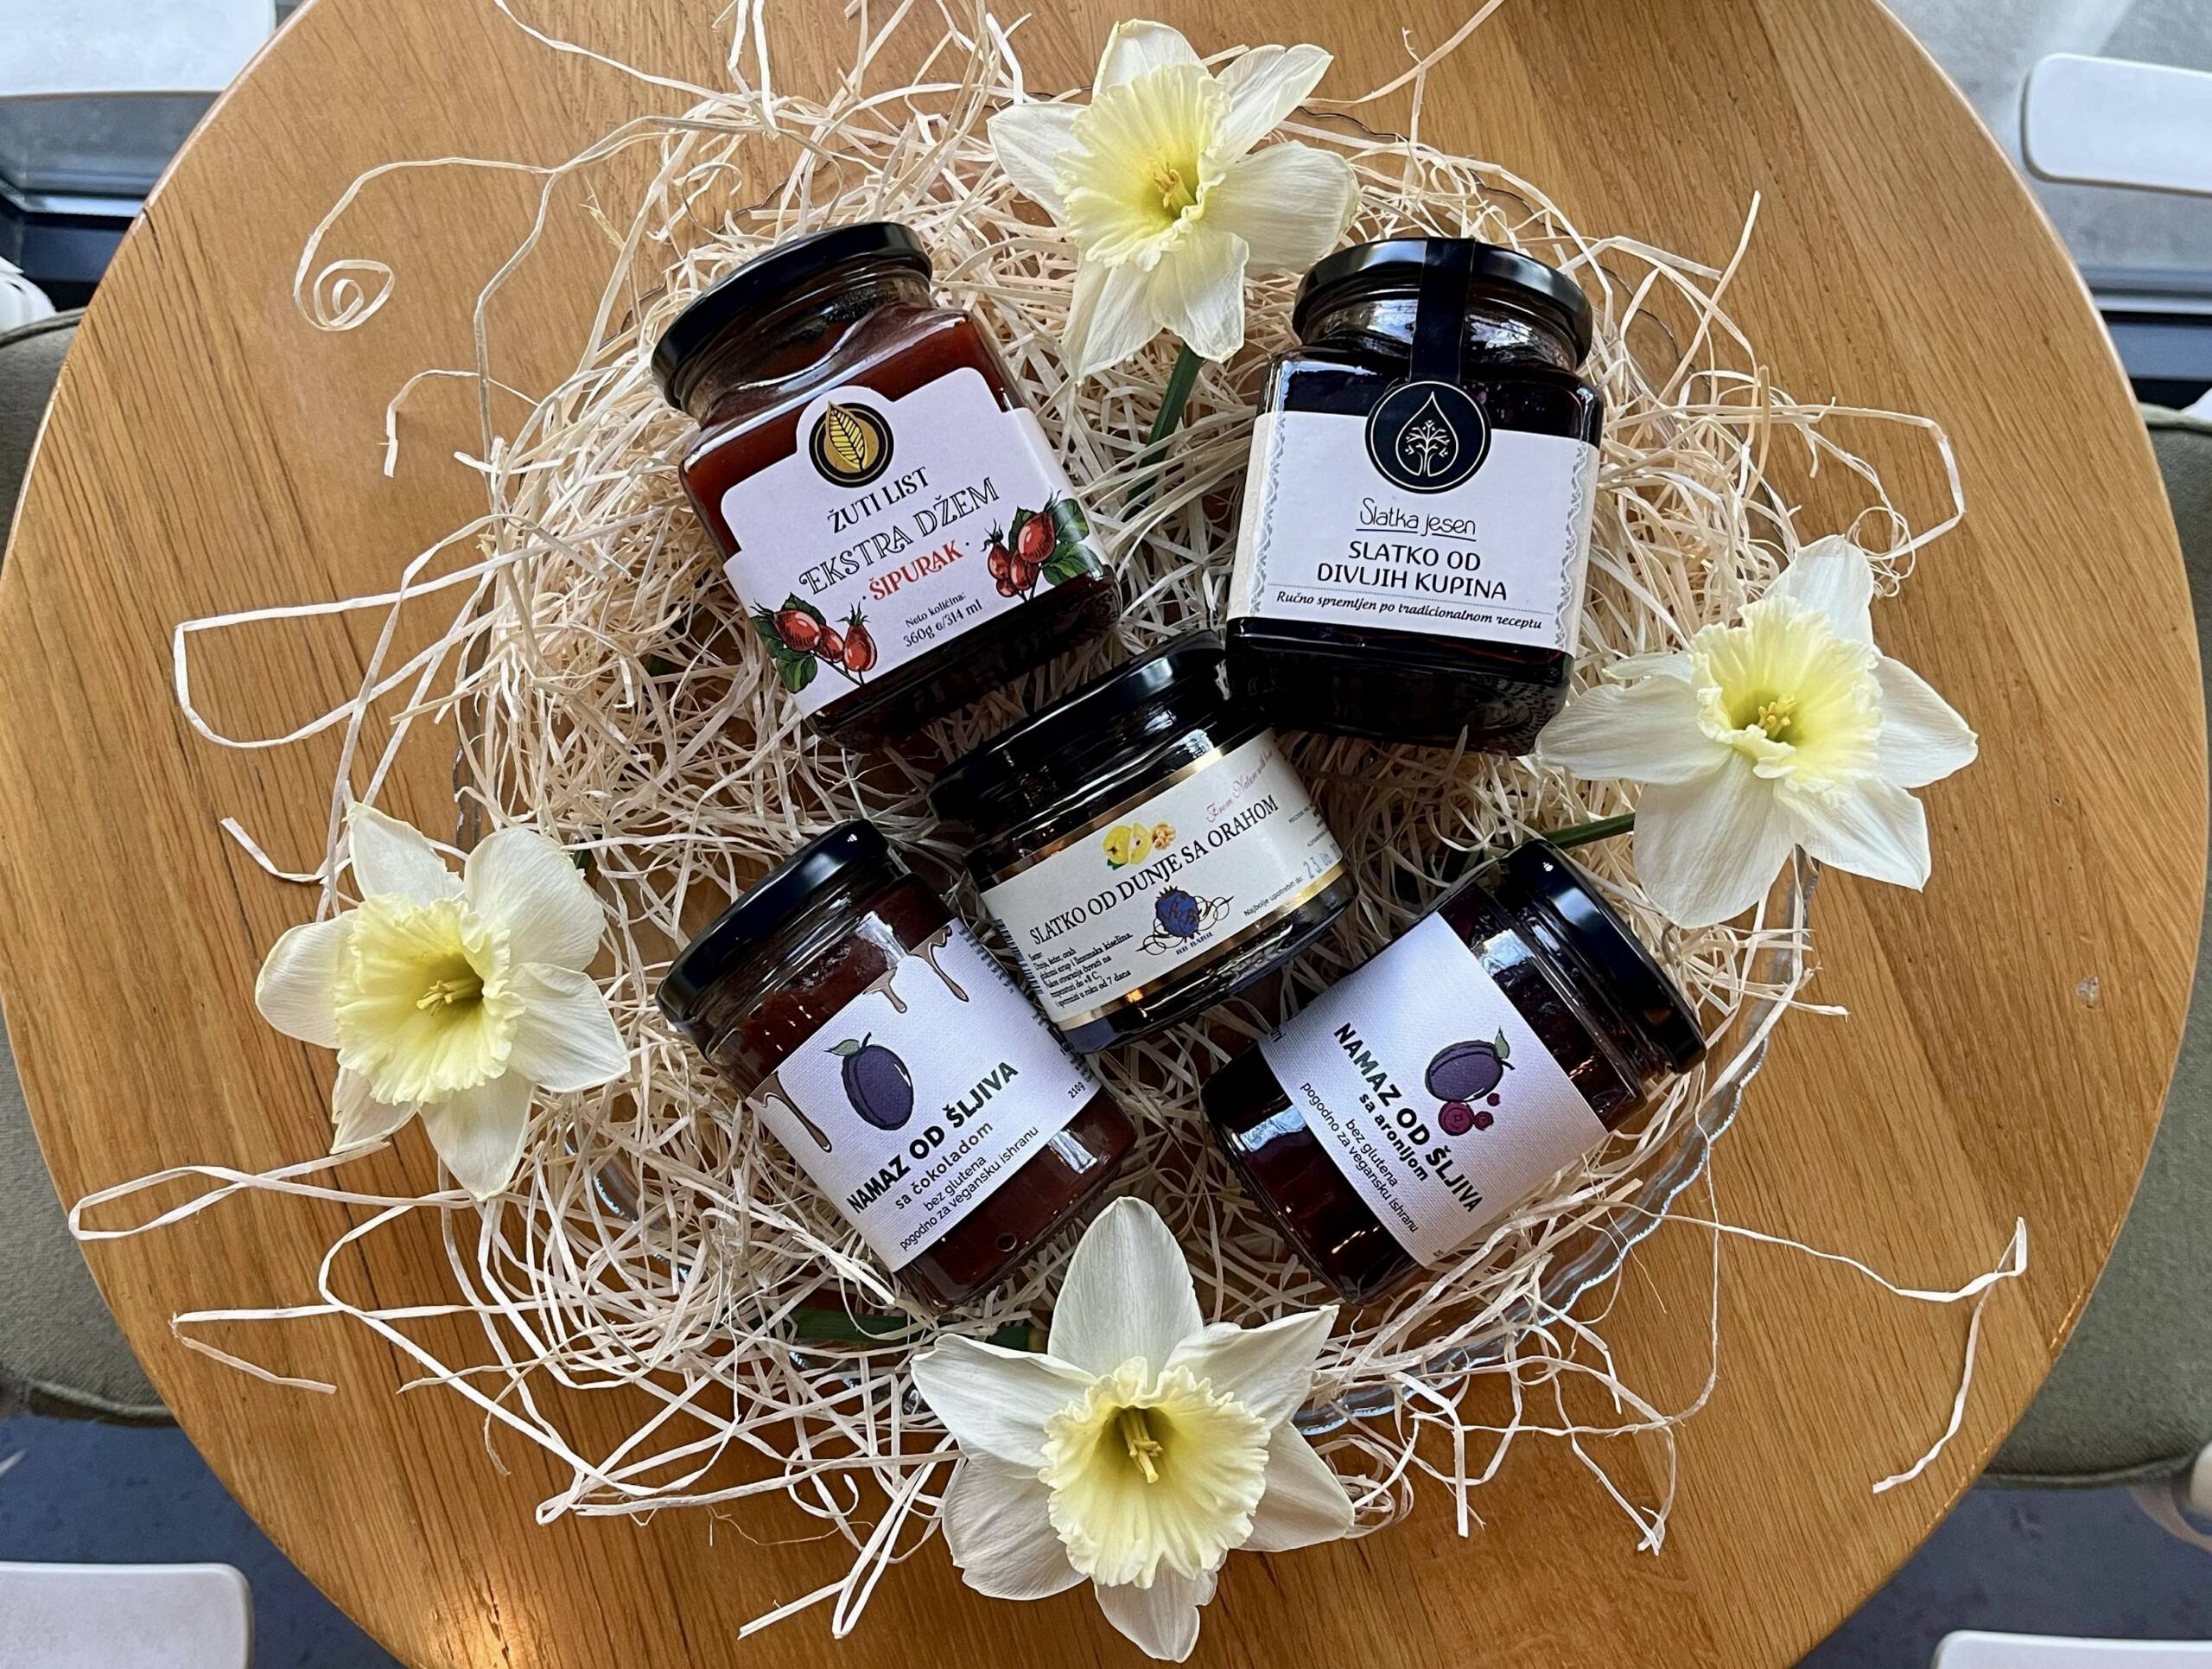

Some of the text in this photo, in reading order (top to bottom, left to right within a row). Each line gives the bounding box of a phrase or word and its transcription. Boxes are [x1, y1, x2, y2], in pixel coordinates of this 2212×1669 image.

[827, 467, 931, 533] ŽUTI LIST
[1360, 498, 1475, 536] Slatka jesen
[799, 477, 1000, 595] EKSTRA DŽEM
[1348, 540, 1480, 571] SLATKO OD
[868, 540, 963, 601] ŠIPURAK
[1317, 563, 1506, 601] DIVLJIH KUPINA
[903, 625, 935, 647] 360g
[966, 599, 982, 615] ml
[906, 592, 966, 627] Neto količina:
[1277, 591, 1541, 629] Ručno spremljen po tradicionalnom receptu
[1029, 906, 1086, 945] SLATKO
[1088, 889, 1119, 917] OD
[1118, 854, 1183, 901] DUNJE
[1184, 840, 1211, 866] SA
[1208, 794, 1279, 850] ORAHOM
[1068, 1081, 1086, 1099] 210g
[1333, 1023, 1483, 1213] NAMAZ OD ŠLJIVA
[847, 1062, 1019, 1214] NAMAZ OD ŠLJIVA
[895, 1123, 993, 1210] sa čokoladom
[1300, 1082, 1419, 1233] pogodno za vegansku ishranu
[1345, 1119, 1398, 1187] bez glutena
[1359, 1093, 1428, 1182] sa aronijom
[900, 1128, 1039, 1251] pogodno za vegansku ishranu
[923, 1156, 987, 1212] bez glutena
